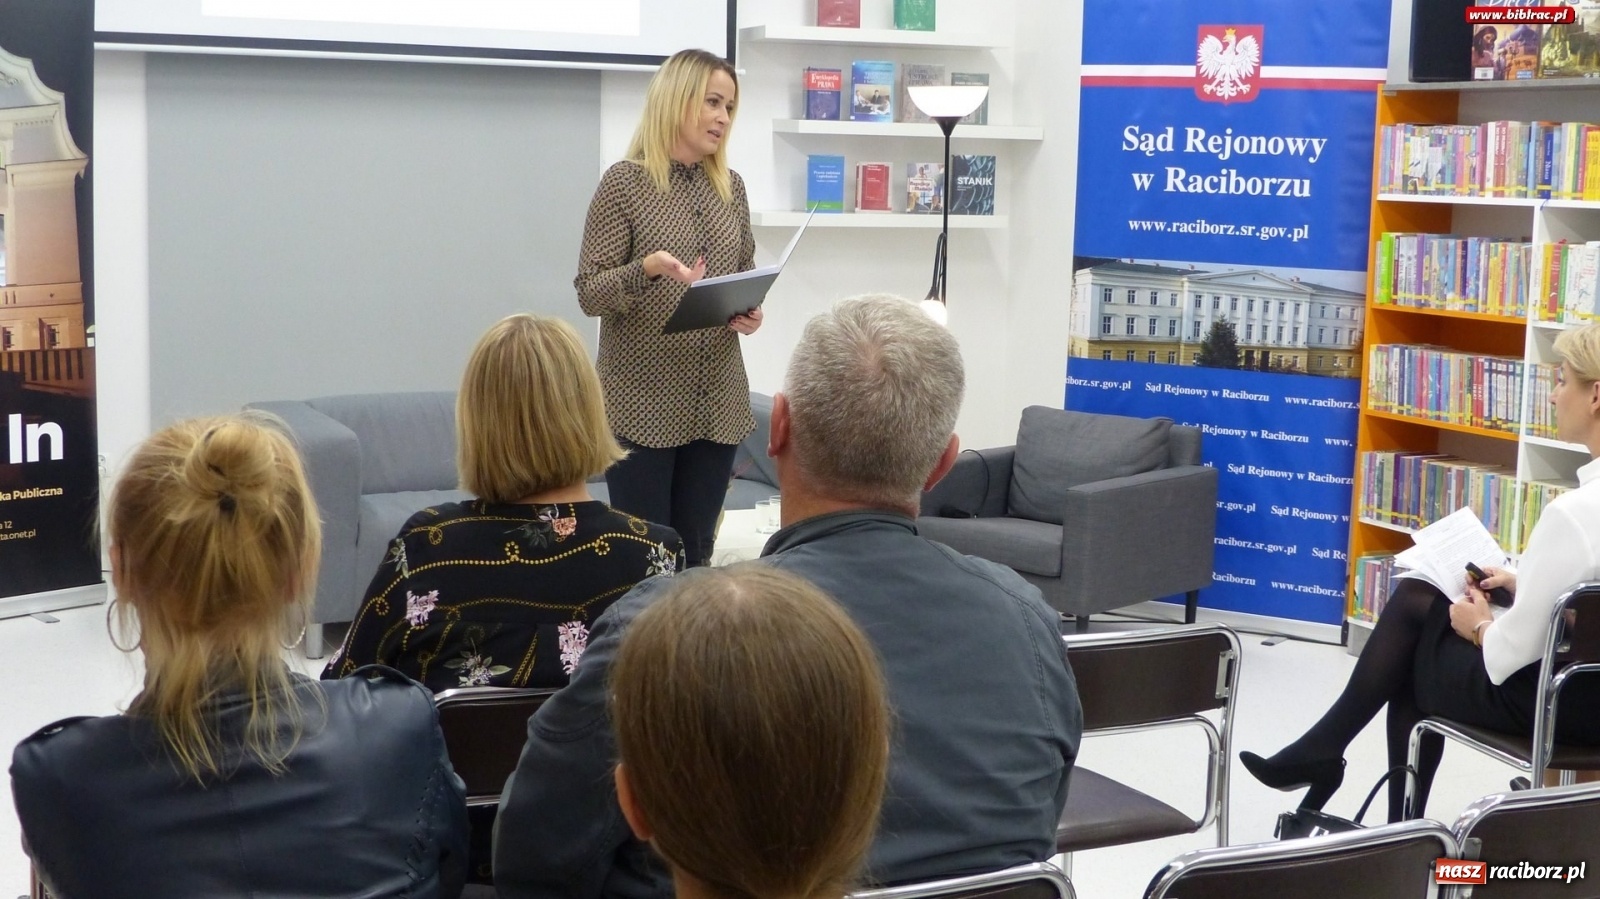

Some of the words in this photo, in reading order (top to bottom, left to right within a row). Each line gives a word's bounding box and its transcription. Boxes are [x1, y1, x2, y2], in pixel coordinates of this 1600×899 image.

[1122, 125, 1174, 157] Sąd
[1183, 126, 1327, 163] Rejonowy
[957, 176, 993, 186] STANIK
[1132, 172, 1155, 192] w
[1164, 166, 1311, 198] Raciborzu
[1128, 218, 1309, 242] www.raciborz.sr.gov.pl
[1145, 381, 1162, 393] Sąd
[1164, 383, 1210, 398] Rejonowy
[1212, 389, 1220, 397] w
[1222, 388, 1270, 402] Raciborzu
[8, 413, 64, 464] In
[1202, 423, 1248, 438] Rejonowy
[1250, 430, 1259, 438] w
[1261, 429, 1309, 443] Raciborzu
[1227, 463, 1245, 474] Sąd
[1248, 466, 1294, 481] Rejonowy
[1297, 472, 1305, 480] w
[13, 487, 64, 500] Publiczna
[1271, 505, 1289, 517] Sąd
[1292, 507, 1339, 523] Rejonowy
[1341, 514, 1350, 522] w
[4, 520, 13, 529] 12
[1312, 547, 1330, 559] Sąd
